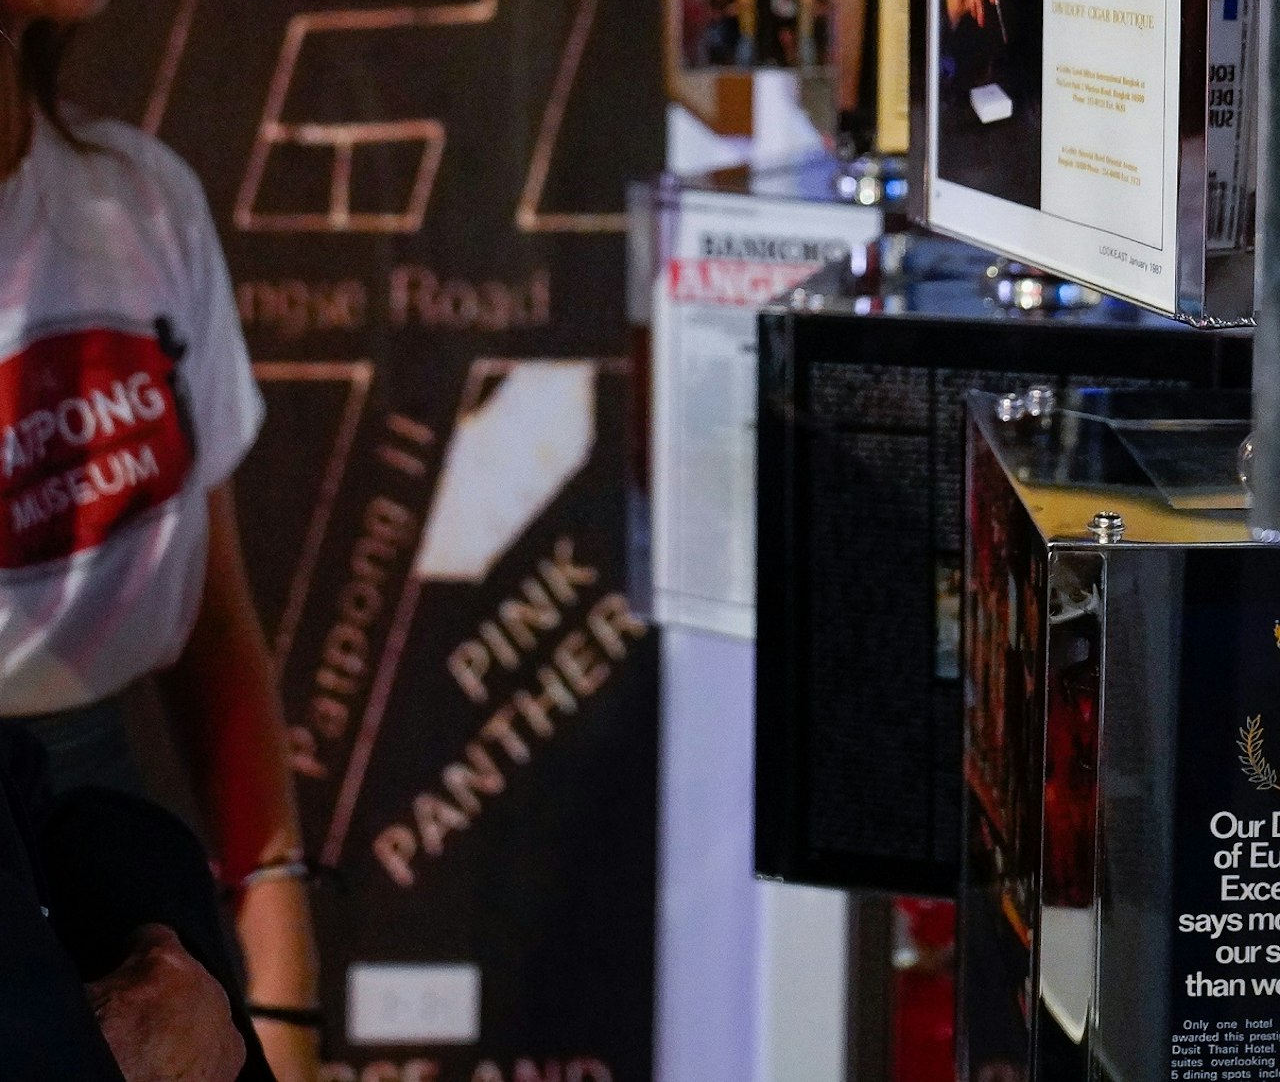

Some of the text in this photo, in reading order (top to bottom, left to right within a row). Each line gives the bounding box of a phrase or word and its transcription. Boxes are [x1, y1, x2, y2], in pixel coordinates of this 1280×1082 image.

[9, 445, 160, 532] MUSEUM
[446, 534, 600, 705] PINK
[373, 591, 649, 888] PANTHER
[1210, 811, 1266, 839] Our
[1214, 842, 1243, 869] of
[1178, 912, 1244, 939] says
[1216, 944, 1262, 964] our
[1185, 971, 1246, 997] than
[1172, 1032, 1225, 1042] awarded
[1224, 1031, 1244, 1041] this
[1183, 1020, 1209, 1031] Only
[1216, 1021, 1237, 1029] one
[1245, 1019, 1273, 1029] hotel
[1171, 1057, 1203, 1067] suites
[1211, 1056, 1275, 1068] overlooking
[1172, 1045, 1201, 1055] Dusit
[1208, 1045, 1239, 1054] Thani
[1245, 1044, 1276, 1054] Hotel.
[1171, 1071, 1178, 1080] 5
[1183, 1070, 1217, 1081] dining
[1222, 1070, 1251, 1081] spots
